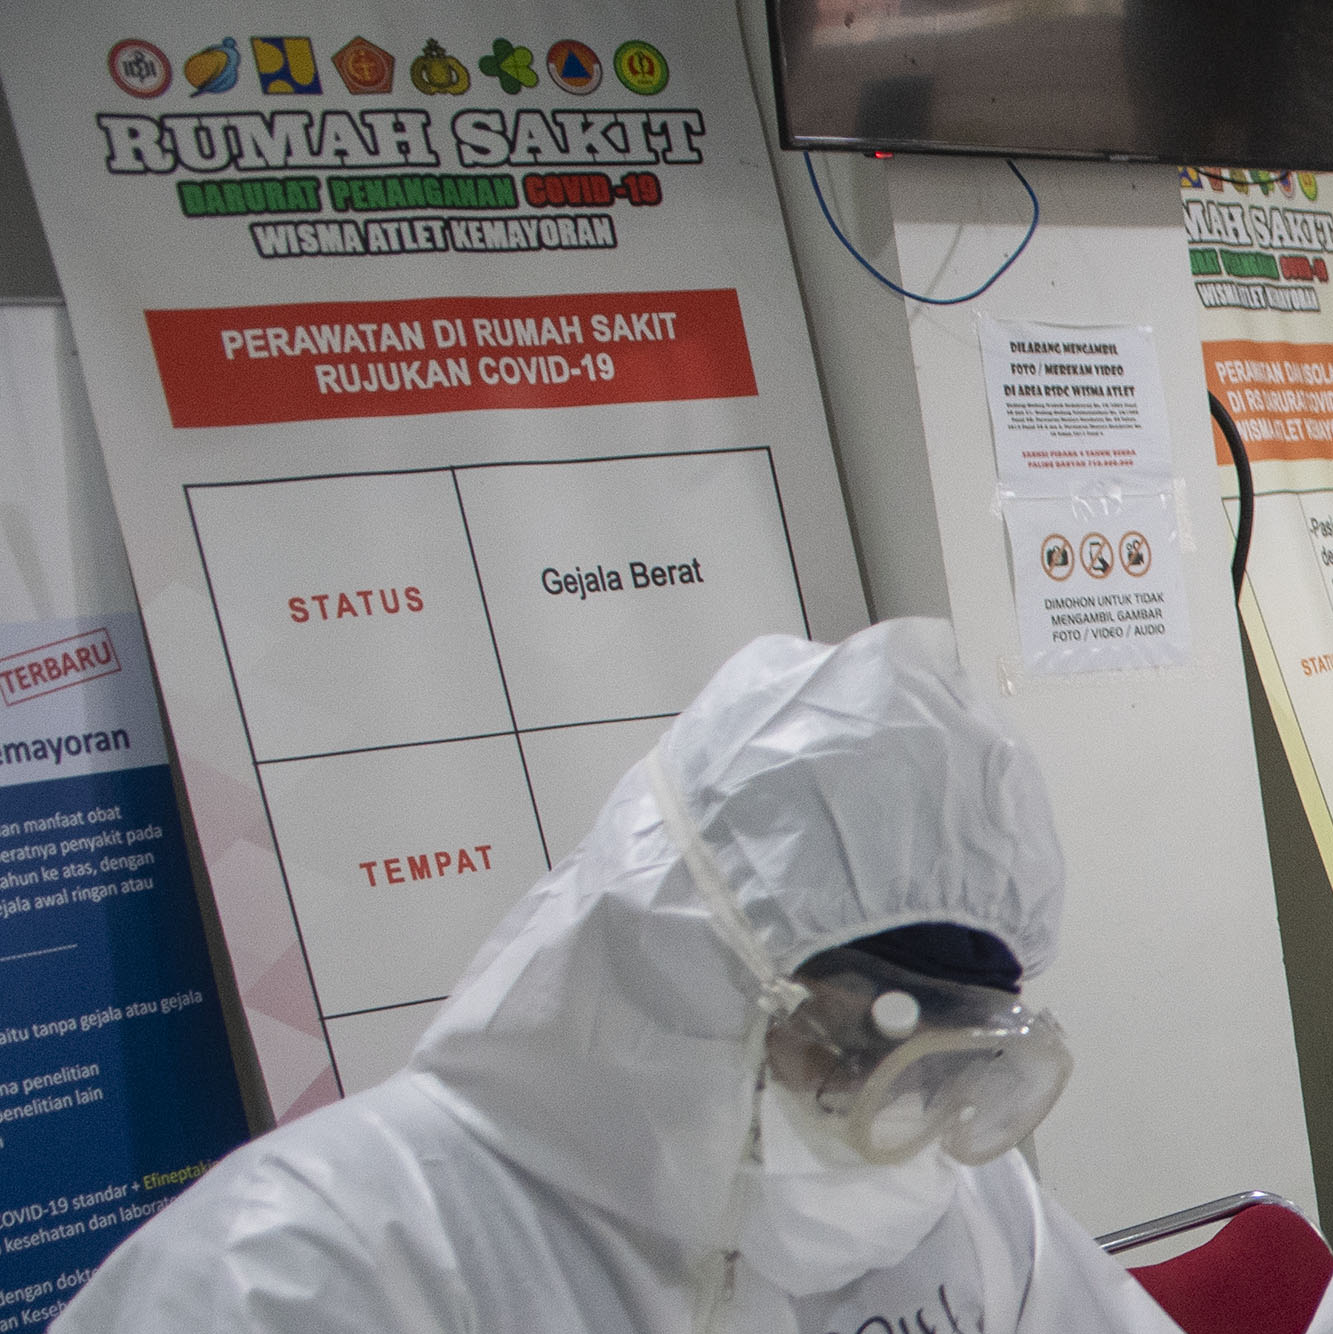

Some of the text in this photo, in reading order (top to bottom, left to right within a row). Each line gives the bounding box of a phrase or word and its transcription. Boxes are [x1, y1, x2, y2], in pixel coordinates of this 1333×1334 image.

[98, 109, 705, 173] RUMAH SAKIT
[176, 172, 662, 218] DARURAT PENANGANAN COVID-19
[251, 216, 617, 257] WISMA ATLET KEMAYORAN
[221, 311, 678, 360] PERAWATAN DI RUMAH SAKIT
[1010, 341, 1119, 355] DILARANG MENGAMBIL
[316, 352, 616, 394] RUJUKAN COVID-19
[1010, 363, 1036, 376] FOTO
[1045, 364, 1093, 376] MEREKAM
[1094, 364, 1125, 377] VIDEO
[1004, 384, 1136, 397] DI AREA RSDC WISMA ATLET
[1227, 390, 1246, 413] DI
[1245, 389, 1264, 412] RS
[540, 556, 705, 602] Gejala Berat
[288, 586, 426, 626] STATUS
[1044, 592, 1165, 610] DIMOHON UNTUK TIDAK
[1051, 607, 1163, 626] MENGAMBIL GAMBAR
[1052, 629, 1081, 642] FOTO
[1091, 627, 1124, 639] VIDEO
[1134, 624, 1166, 636] AUDIO
[1, 641, 113, 694] TERBARU
[23, 810, 85, 834] manfaat
[87, 805, 122, 823] obat
[61, 829, 123, 856] penyakit
[126, 824, 163, 847] pada
[41, 866, 59, 882] ke
[62, 861, 98, 882] atas,
[100, 850, 155, 875] dengan
[358, 844, 496, 888] TEMPAT
[34, 888, 70, 911] awal
[72, 880, 118, 906] ringan
[121, 876, 154, 896] atau
[31, 1014, 77, 1040] tanpa
[79, 1005, 123, 1033] gejala
[125, 998, 158, 1019] atau
[160, 989, 203, 1013] gejala
[22, 1064, 100, 1095] penelitian
[75, 1087, 104, 1105] lain
[72, 1184, 128, 1211] standar
[5, 1221, 86, 1253] kesehatan
[88, 1213, 117, 1232] dan
